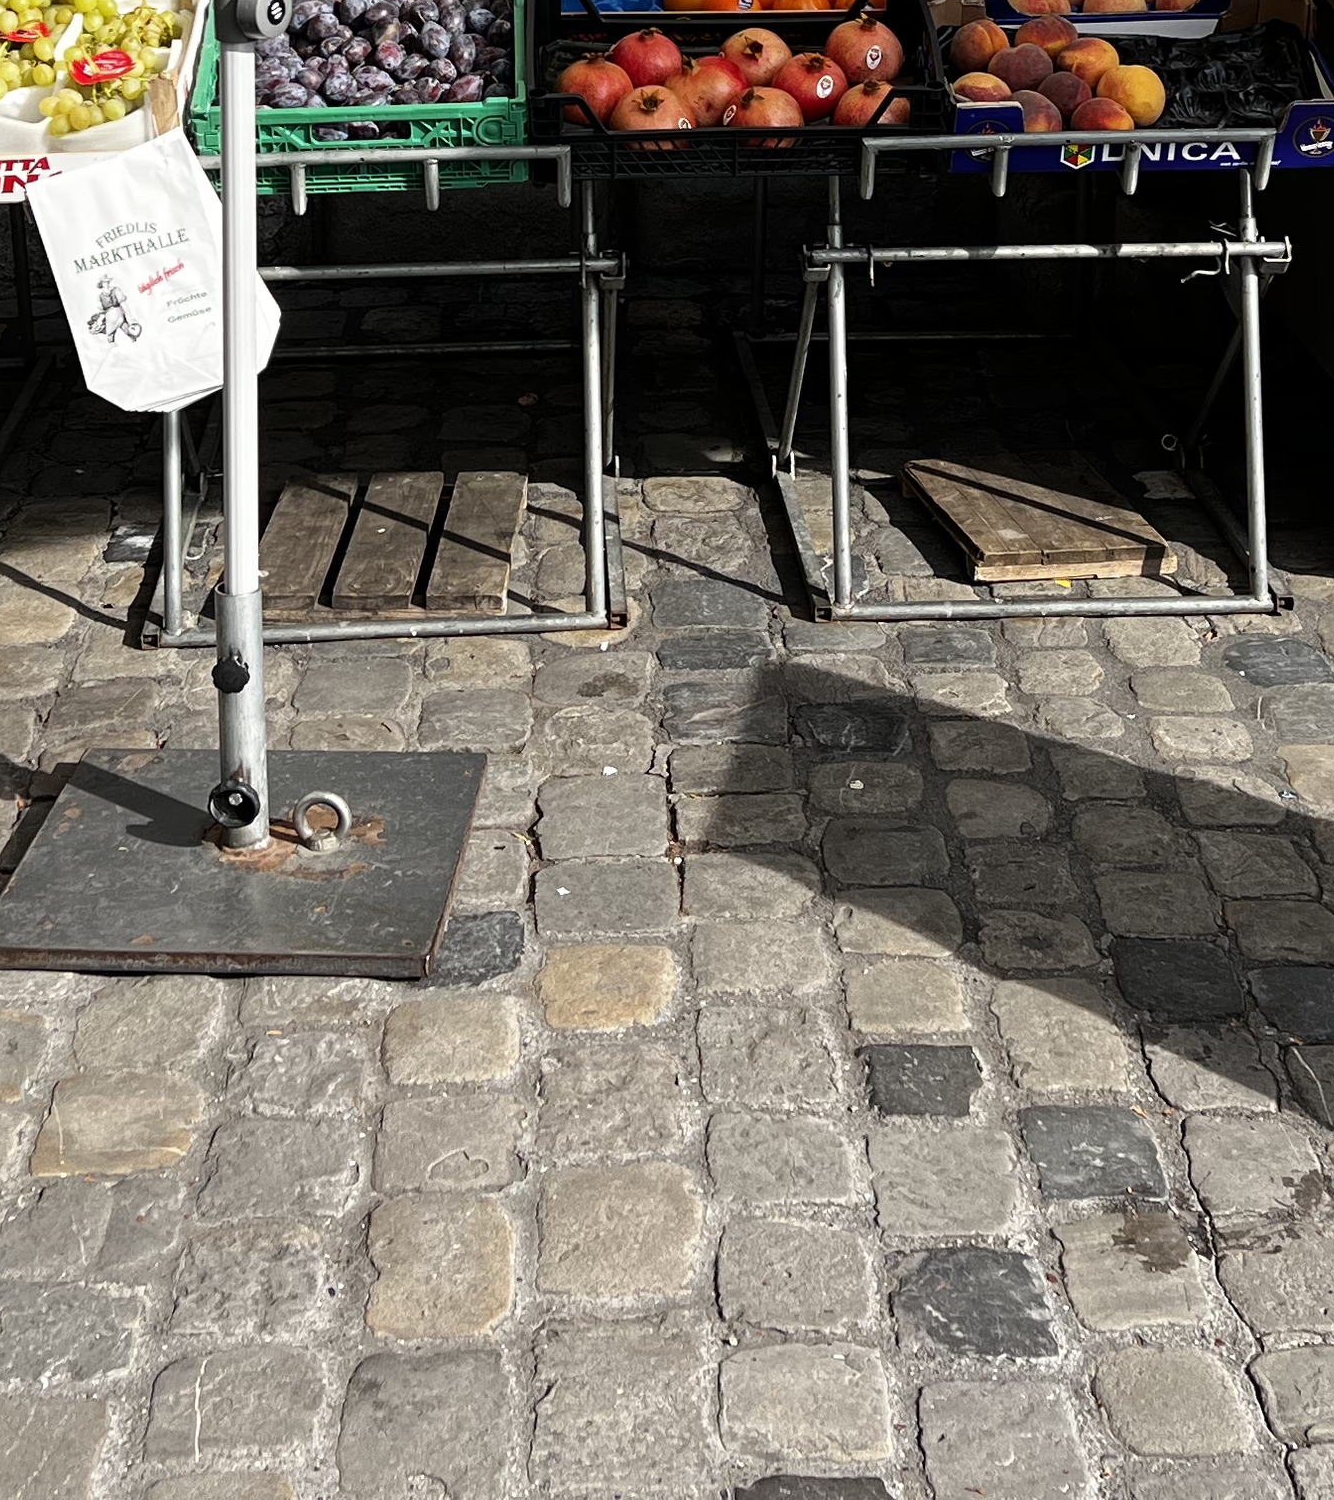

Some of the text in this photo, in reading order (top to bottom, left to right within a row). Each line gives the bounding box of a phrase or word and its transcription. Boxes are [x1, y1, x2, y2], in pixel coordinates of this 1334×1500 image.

[95, 221, 158, 249] FRIEDLIS
[73, 228, 190, 275] MARKTHALLE
[166, 290, 209, 308] Früchte
[167, 305, 213, 324] Gemüse
